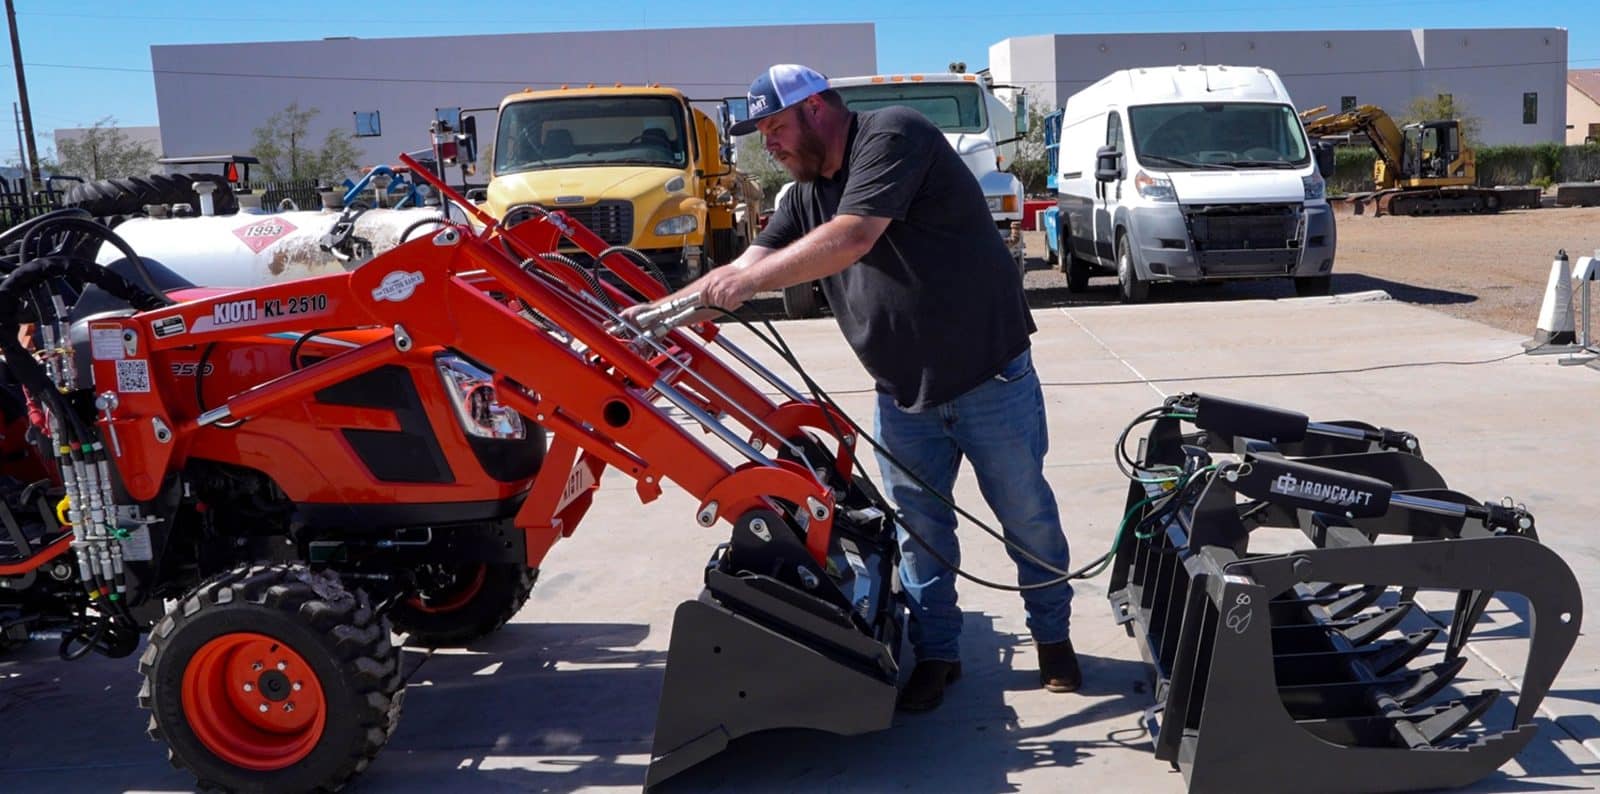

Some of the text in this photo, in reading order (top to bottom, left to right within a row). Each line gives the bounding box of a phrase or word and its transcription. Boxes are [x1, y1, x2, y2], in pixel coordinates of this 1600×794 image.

[247, 224, 283, 237] 1993
[213, 294, 327, 325] KIOTI KL 2510
[1300, 480, 1373, 506] IRONCRAFT
